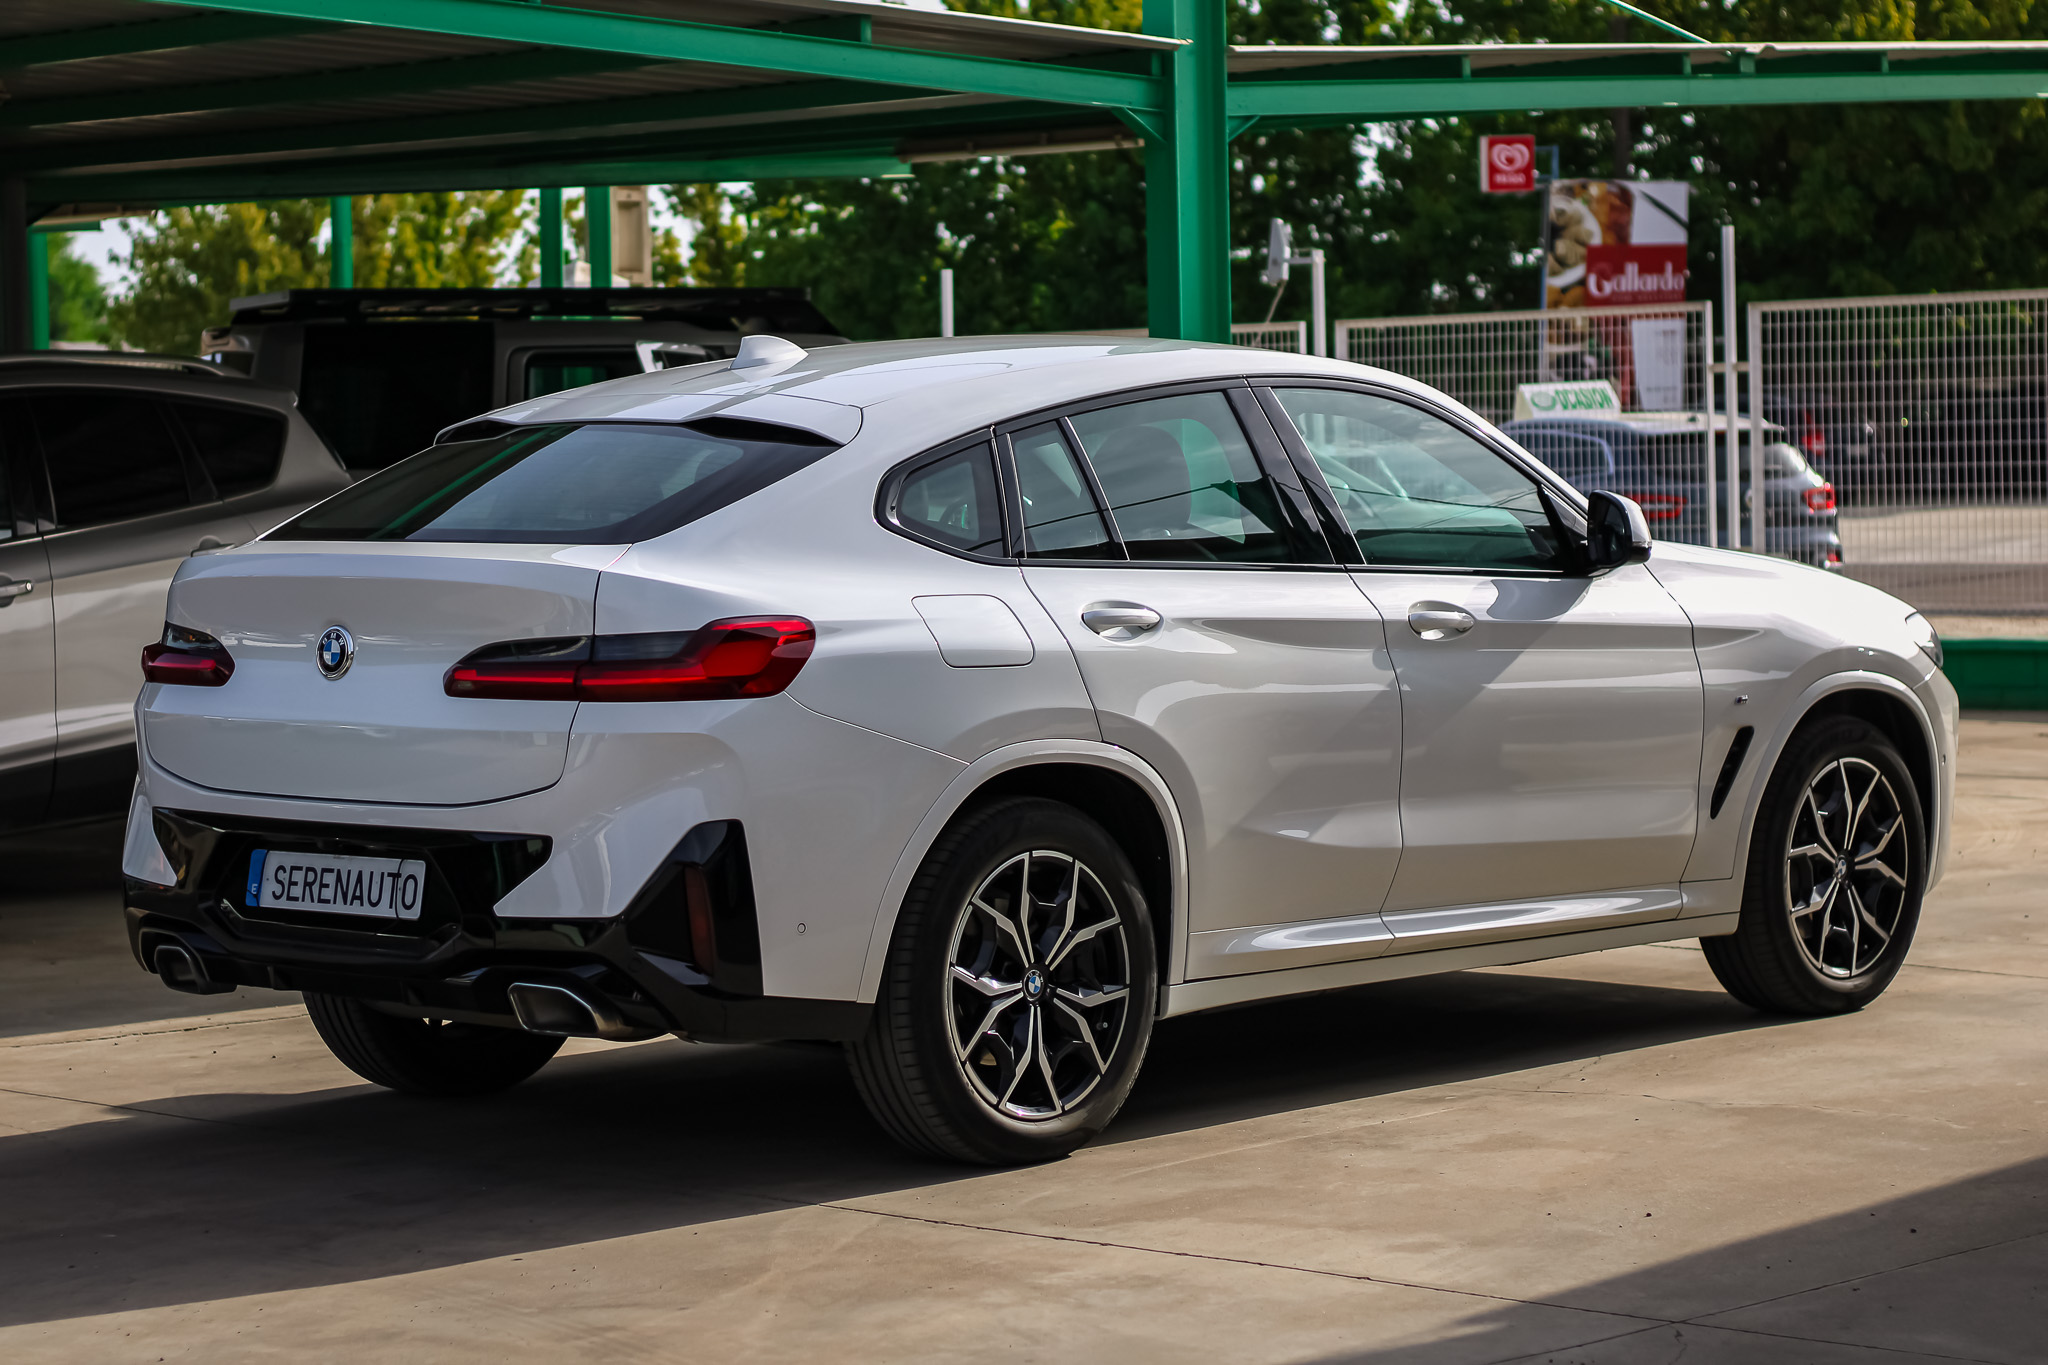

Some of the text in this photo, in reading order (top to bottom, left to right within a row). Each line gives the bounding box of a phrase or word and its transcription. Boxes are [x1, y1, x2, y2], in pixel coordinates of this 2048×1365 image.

[1588, 262, 1685, 297] Gallardo
[322, 632, 344, 646] BMW
[251, 883, 258, 894] E
[272, 864, 419, 911] SERENAUTO
